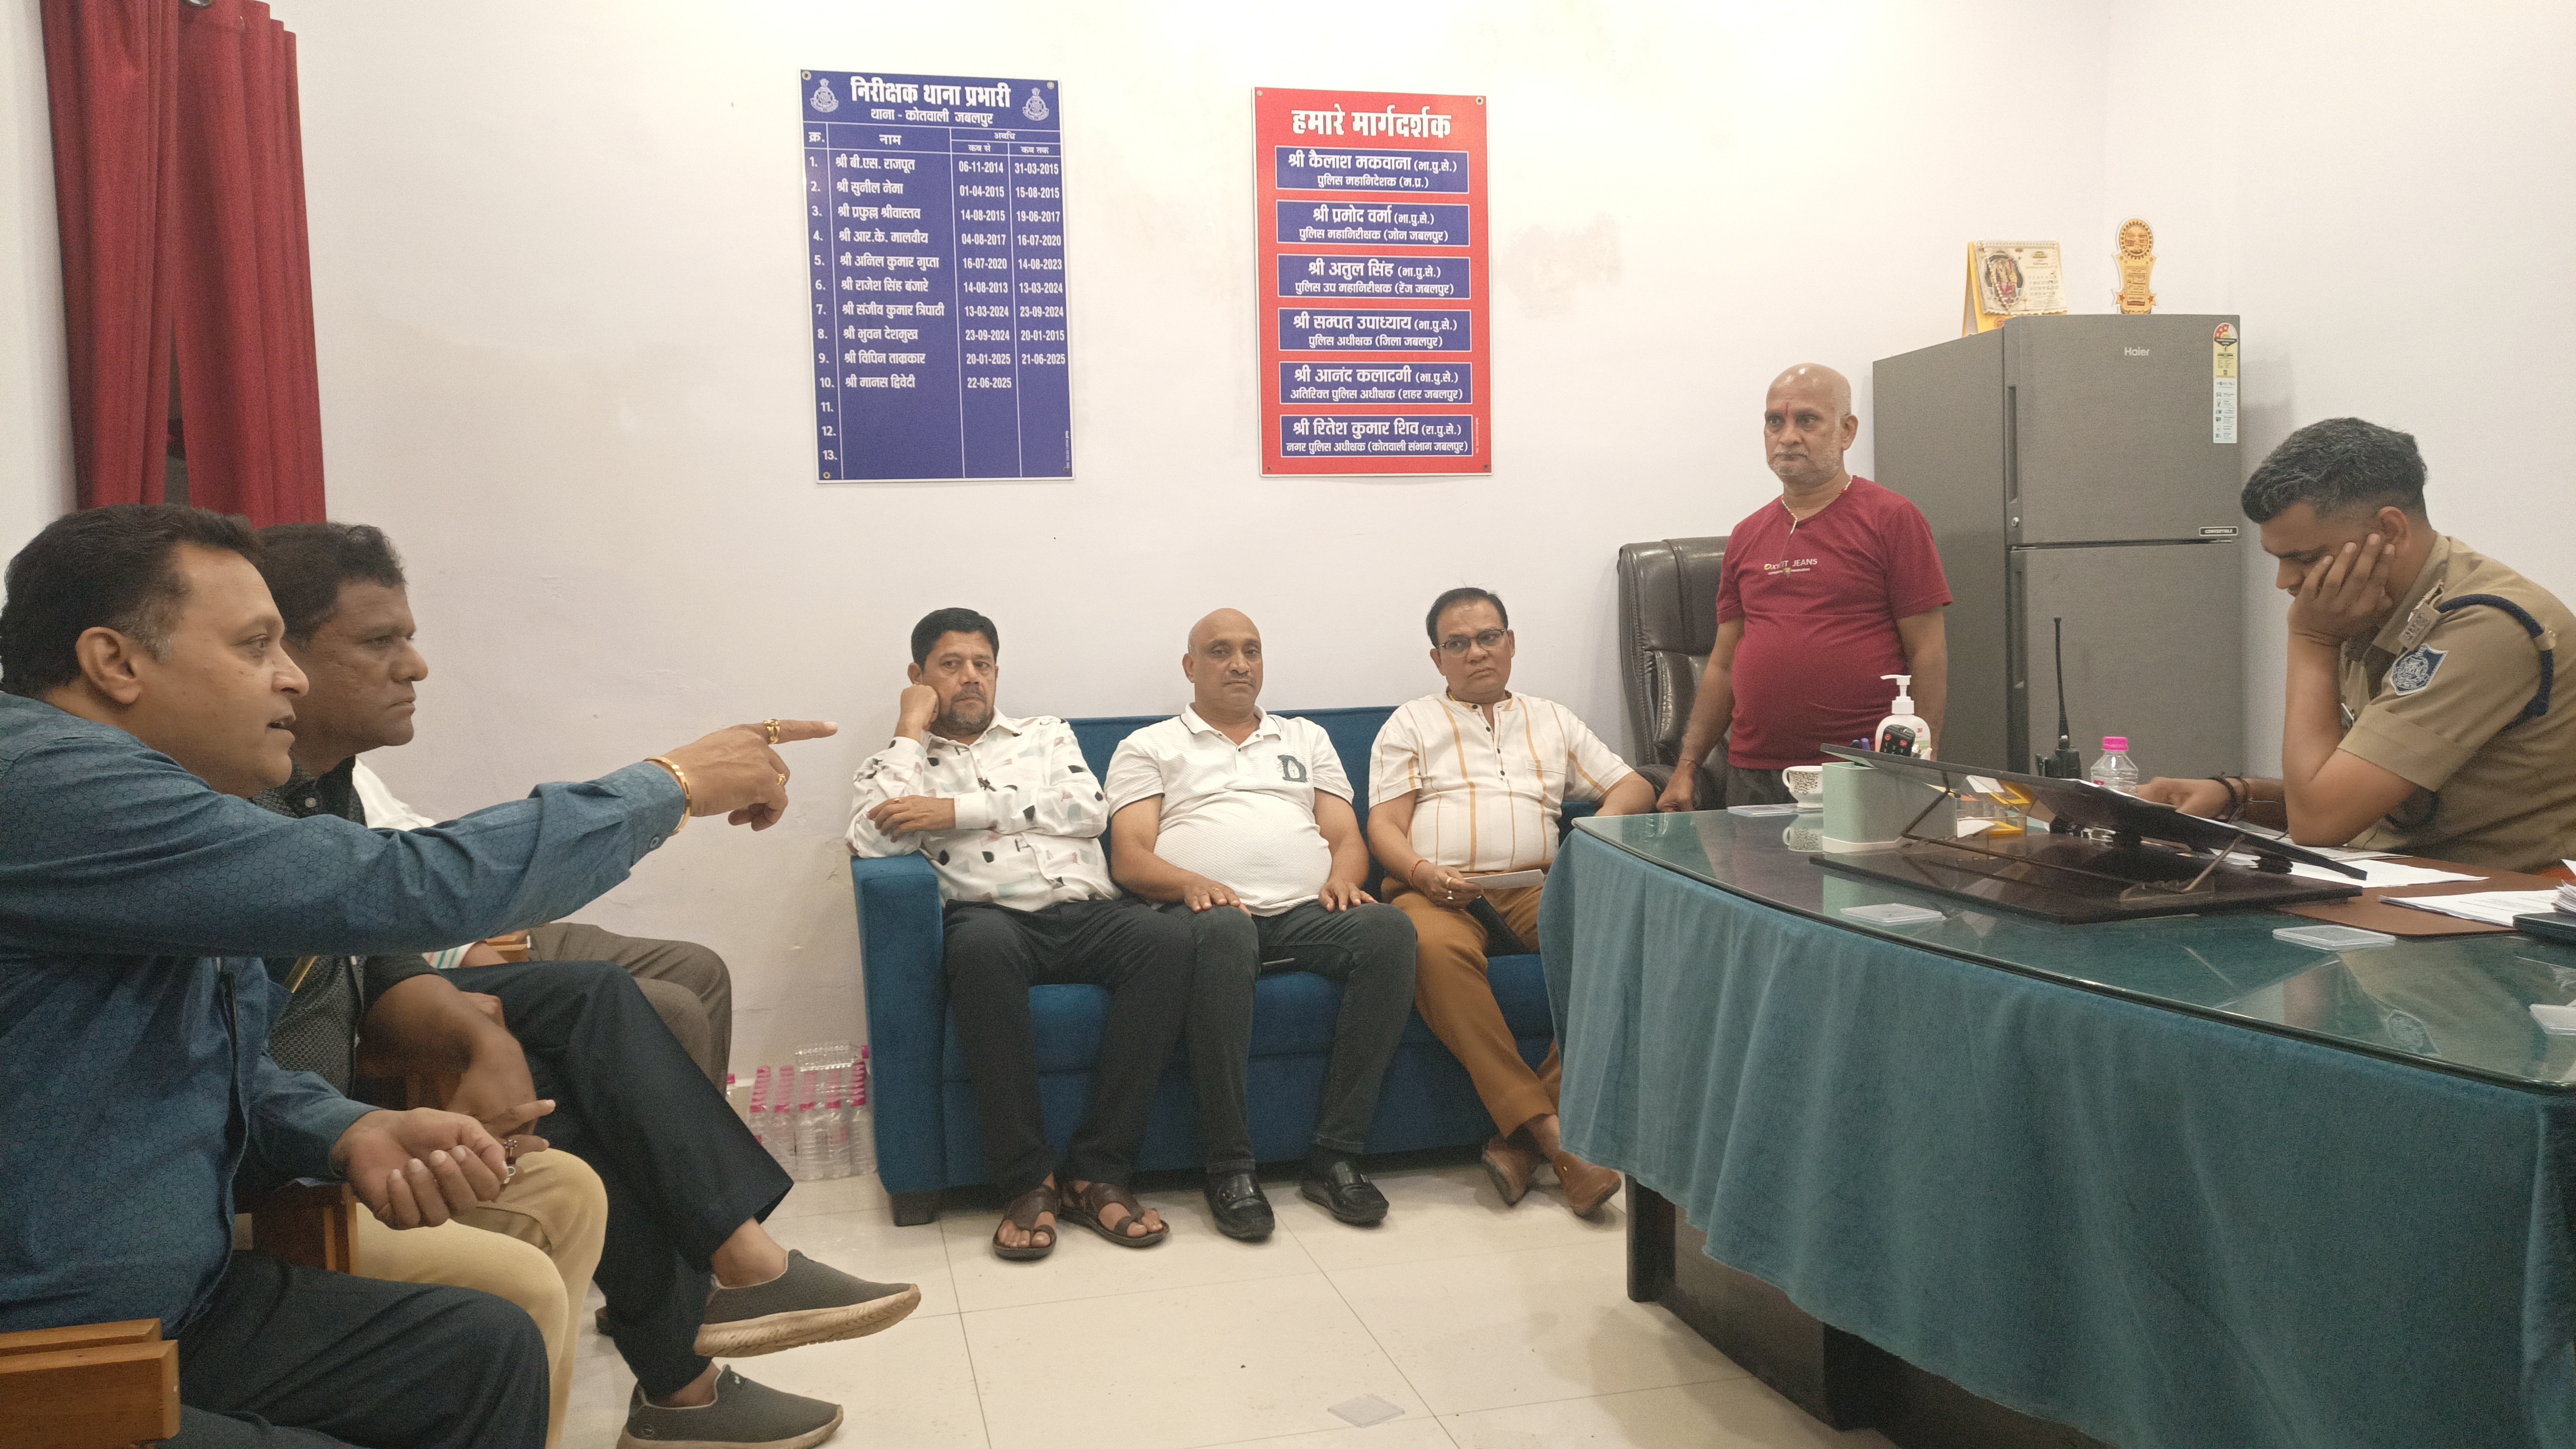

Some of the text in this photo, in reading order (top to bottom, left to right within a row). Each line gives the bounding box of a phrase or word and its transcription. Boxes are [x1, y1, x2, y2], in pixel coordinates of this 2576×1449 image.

[850, 75, 1011, 108] निरीक्षक थाना प्रभारी
[870, 108, 895, 120] थाना
[905, 106, 950, 122] कोतवाली
[954, 111, 994, 127] जबलपुर
[1291, 103, 1452, 139] हमारे मार्गदर्शक
[879, 134, 902, 145] नाम
[993, 131, 1016, 140] अवधि
[983, 143, 991, 153] से
[809, 156, 818, 167] 1.
[835, 153, 848, 168] श्री
[883, 158, 916, 174] राजपूत
[958, 160, 1004, 173] 06-11-2014
[1288, 149, 1457, 174] श्री कैलाश मकवाना (भा.पु.से.)
[1014, 162, 1059, 175] 31-03-2015
[810, 180, 821, 192] 2.
[1317, 172, 1343, 188] पुलिस
[1344, 173, 1397, 187] महानिदेशक
[836, 178, 904, 197] श्री सुनील नेमा
[959, 184, 1005, 197] 01-04-2015
[1015, 186, 1060, 198] 15-08-2015
[811, 205, 822, 216] 3.
[837, 202, 850, 217] श्री
[880, 203, 921, 219] श्रीवास्तव
[960, 209, 1006, 221] 14-08-2015
[1016, 210, 1060, 222] 19-06-2017
[1313, 203, 1434, 227] श्री प्रमोद वर्मा (भा.पु.से.)
[813, 230, 823, 242] 4.
[839, 227, 929, 244] श्री आर.के. मालवीय
[961, 233, 1006, 245] 04-08-2017
[1017, 234, 1062, 247] 16-07-2020
[1299, 225, 1448, 244] पुलिस महानिरीक्षक (जोन जबलपुर)
[814, 254, 825, 266] 5.
[840, 252, 940, 271] श्री अनिल कुमार गुप्ता
[962, 257, 1007, 269] 16-07-2020
[1018, 258, 1062, 270] 14-08-2023
[1308, 257, 1441, 281] श्री अतुल सिंह (भा.पु.से.)
[815, 279, 826, 290] 6.
[841, 276, 929, 292] श्री राजेश सिंह बंजारे
[963, 281, 1008, 293] 14-08-2013
[1019, 282, 1063, 293] 13-03-2024
[1295, 279, 1321, 295] पुलिस
[1323, 283, 1337, 292] उप
[1338, 280, 1393, 293] महानिरीक्षक
[1414, 283, 1454, 297] जबलपुर)
[816, 304, 826, 315] 7.
[842, 300, 945, 319] श्री संजीव कुमार त्रिपाठी
[964, 305, 1009, 317] 13-03-2024
[1020, 306, 1064, 318] 23-09-2024
[1293, 311, 1457, 333] श्री सम्पत उपाध्याय (भा.पु.से.)
[817, 328, 828, 339] 8.
[843, 325, 918, 343] श्री भुवन देशमुख
[965, 329, 1010, 341] 23-09-2024
[1020, 329, 1065, 341] 20-01-2015
[1308, 333, 1443, 349] पुलिस अधीक्षक (जिला जबलपुर)
[818, 352, 830, 363] 9.
[844, 349, 856, 364] श्री
[858, 349, 887, 364] विपिन
[2124, 347, 2150, 356] Haier
[966, 353, 1011, 364] 20-01-2025
[1021, 353, 1066, 365] 21-06-2025
[845, 373, 858, 388] श्री
[859, 377, 889, 388] मानस
[1294, 364, 1459, 385] श्री आनंद कलादगी (भा.पु.से.)
[819, 377, 835, 388] 10.
[967, 377, 1012, 389] 22-06-2025
[1290, 386, 1463, 402] अतिरिक्त पुलिस अधीक्षक (शहर जबलपुर)
[820, 401, 834, 412] 11.
[821, 425, 836, 437] 12.
[1292, 418, 1310, 435] श्री
[1312, 417, 1348, 435] रितेश
[1351, 422, 1391, 439] कुमार
[1393, 417, 1419, 435] शिव
[1421, 422, 1461, 438] (रा.पु.से.)
[1285, 442, 1307, 452] नगर
[1308, 439, 1332, 455] पुलिस
[1333, 439, 1366, 452] अधीक्षक
[1367, 439, 1408, 453] (कोतवाली
[1433, 441, 1468, 454] जबलपुर)
[822, 449, 838, 460] 13.
[1792, 558, 1818, 567] JEANS
